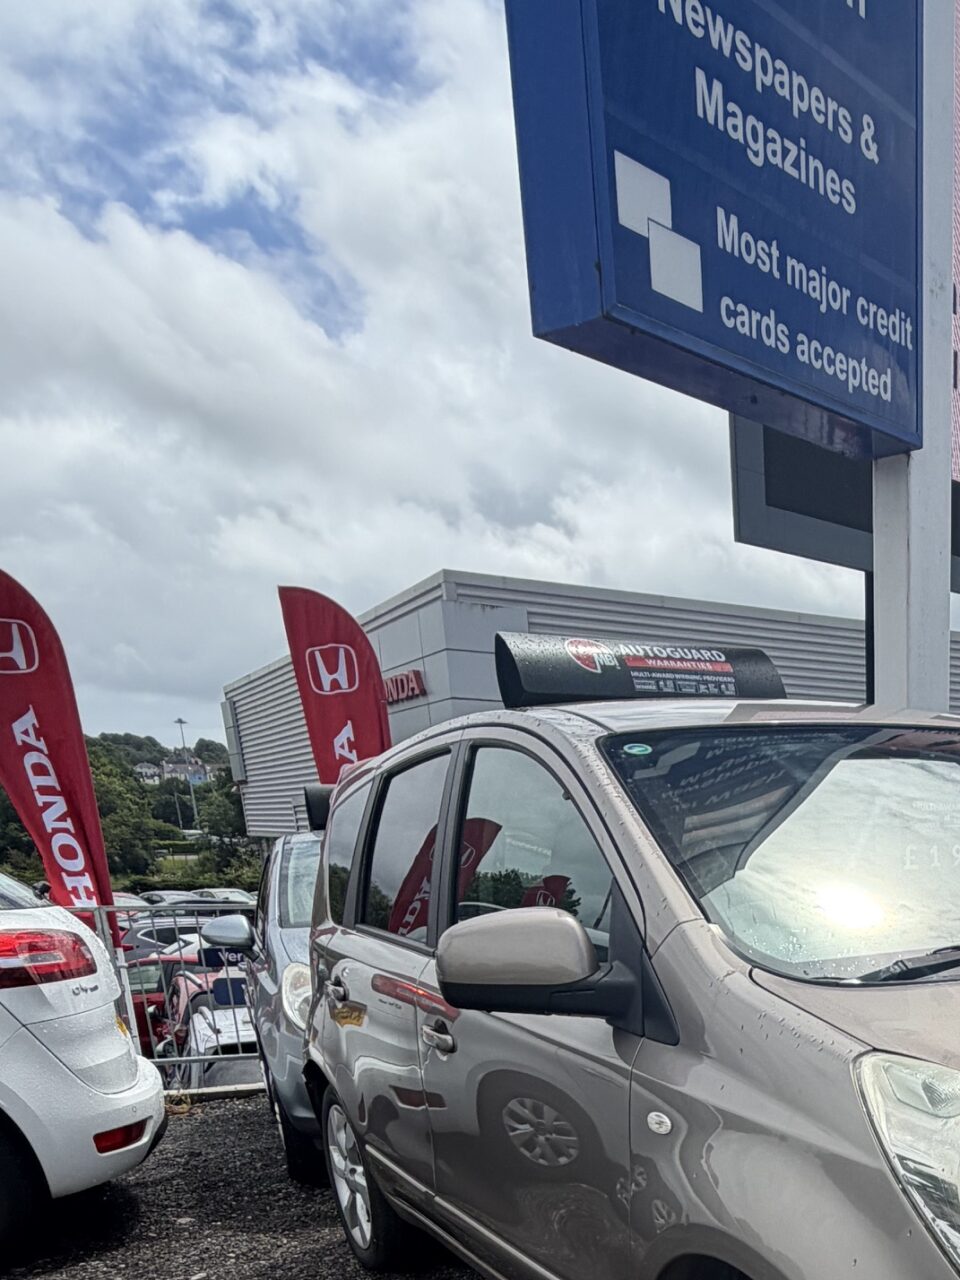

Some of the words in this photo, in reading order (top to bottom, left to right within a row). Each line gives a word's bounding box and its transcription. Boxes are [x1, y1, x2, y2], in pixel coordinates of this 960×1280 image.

[695, 67, 857, 214] Magazines
[861, 114, 880, 164] &
[716, 206, 780, 278] Most
[786, 254, 851, 315] major
[856, 295, 913, 350] credit
[720, 296, 790, 355] cards
[797, 332, 891, 402] accepted
[619, 644, 725, 662] AUTOGUARD
[645, 658, 713, 671] WARRANTIES
[12, 704, 97, 908] HONDA
